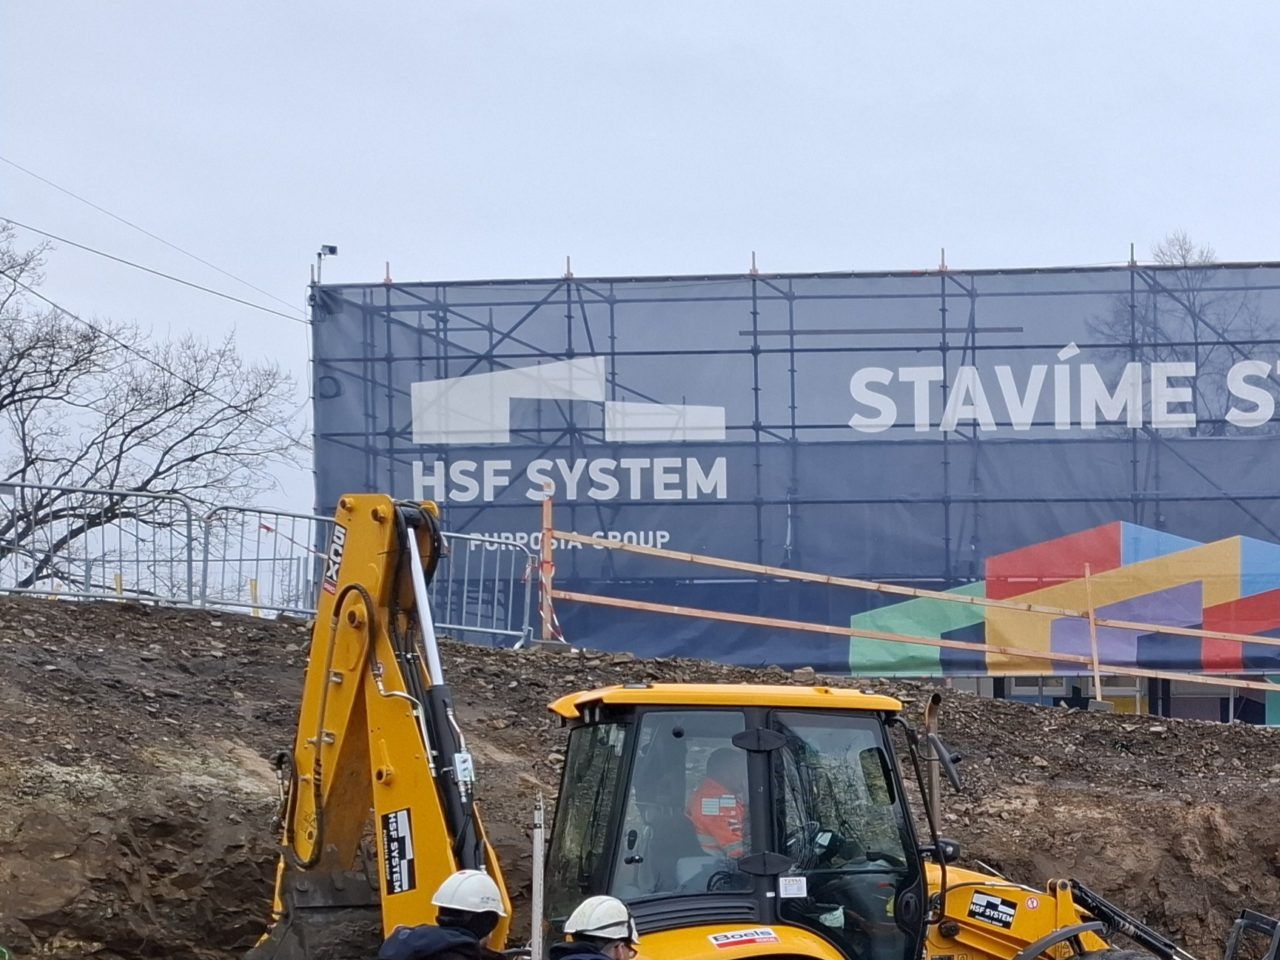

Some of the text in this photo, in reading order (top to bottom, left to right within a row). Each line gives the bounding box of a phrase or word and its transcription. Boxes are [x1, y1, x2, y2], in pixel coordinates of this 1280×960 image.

[847, 341, 1197, 434] STAVÍME
[412, 456, 727, 502] HSF SYSTEM
[388, 812, 402, 894] HSF SYSTEM
[970, 903, 986, 914] HSF
[985, 908, 1014, 923] SYSTEM
[711, 930, 773, 943] Boels
